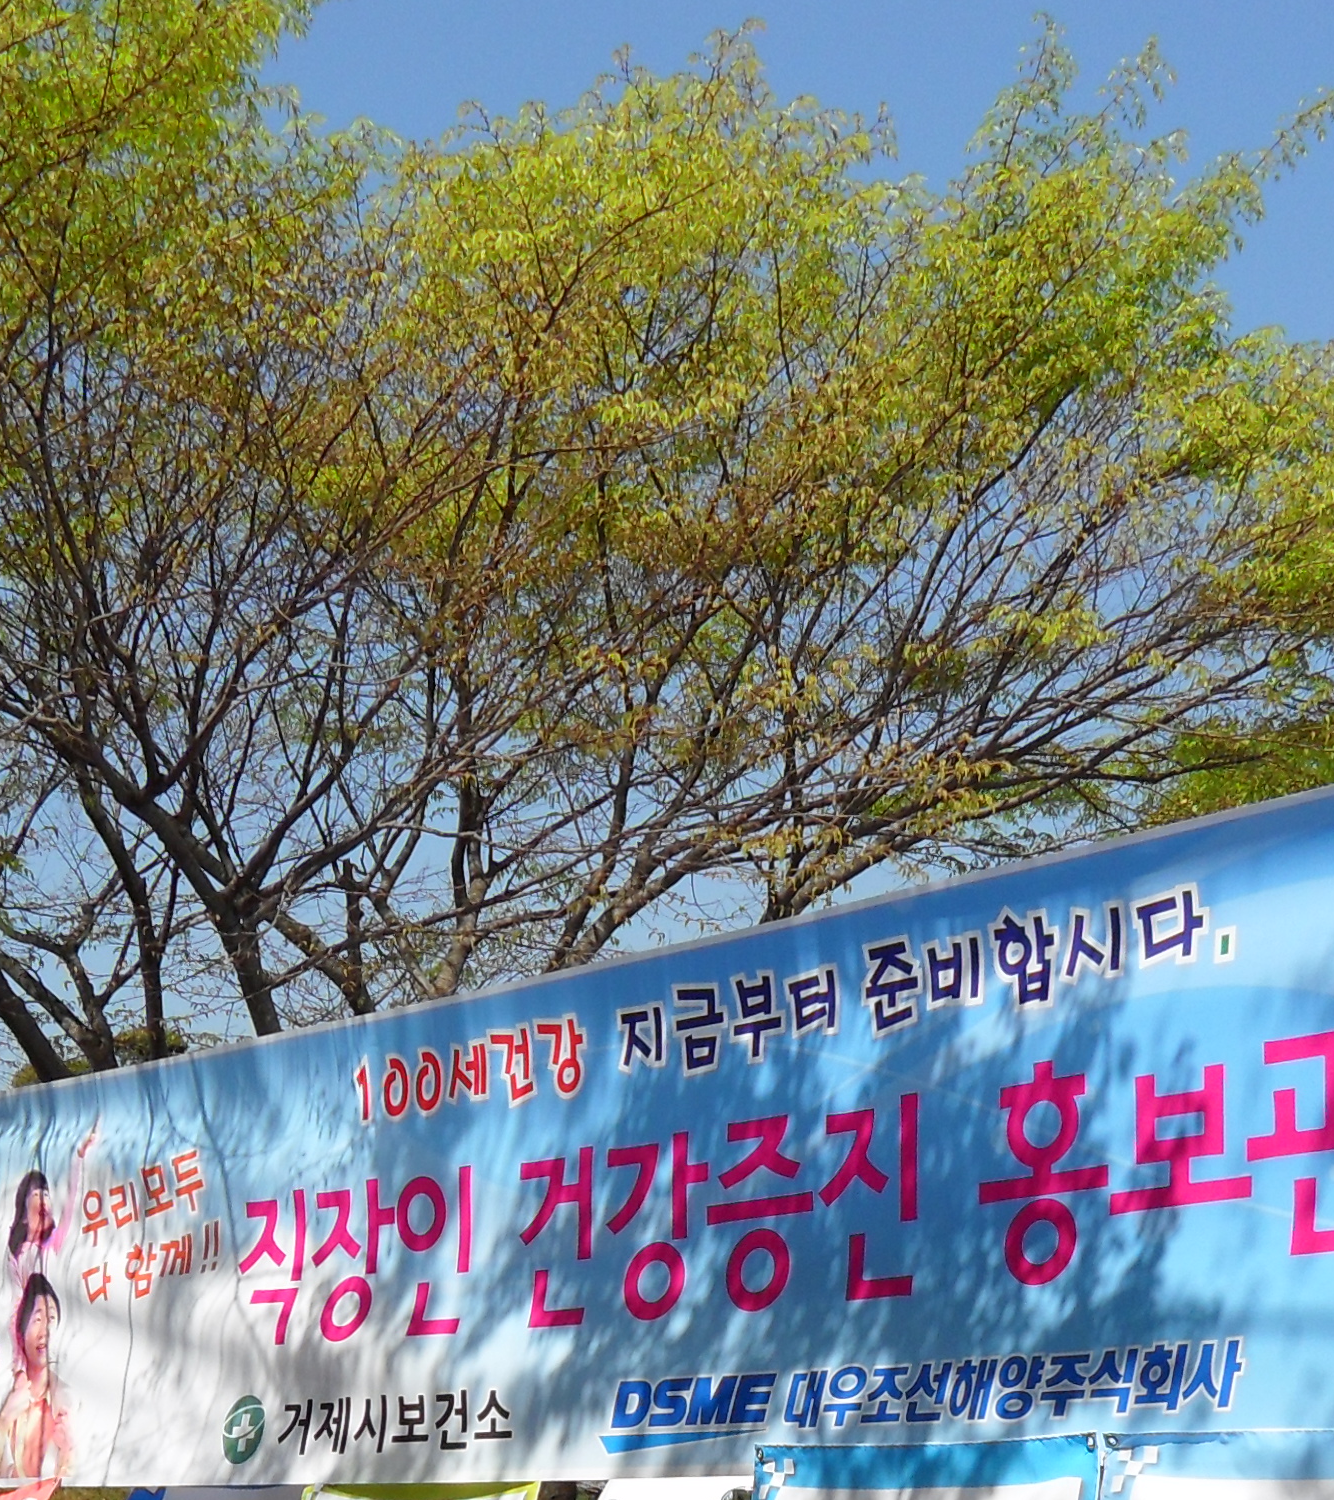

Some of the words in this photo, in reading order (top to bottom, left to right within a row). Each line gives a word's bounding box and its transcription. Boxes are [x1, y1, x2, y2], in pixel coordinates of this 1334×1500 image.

[357, 1018, 584, 1123] 100세건강
[620, 966, 839, 1077] 지금부터
[865, 884, 1236, 1036] 준비합시다.
[82, 1150, 204, 1247] 우리모두
[240, 1166, 471, 1346] 직장인
[520, 1093, 919, 1330] 건강증진
[82, 1262, 111, 1304] 다
[125, 1243, 193, 1299] 함께
[278, 1389, 513, 1457] 거제시보건소
[615, 1373, 777, 1428] DSME
[784, 1337, 1245, 1430] 대우조선해양주식회사
